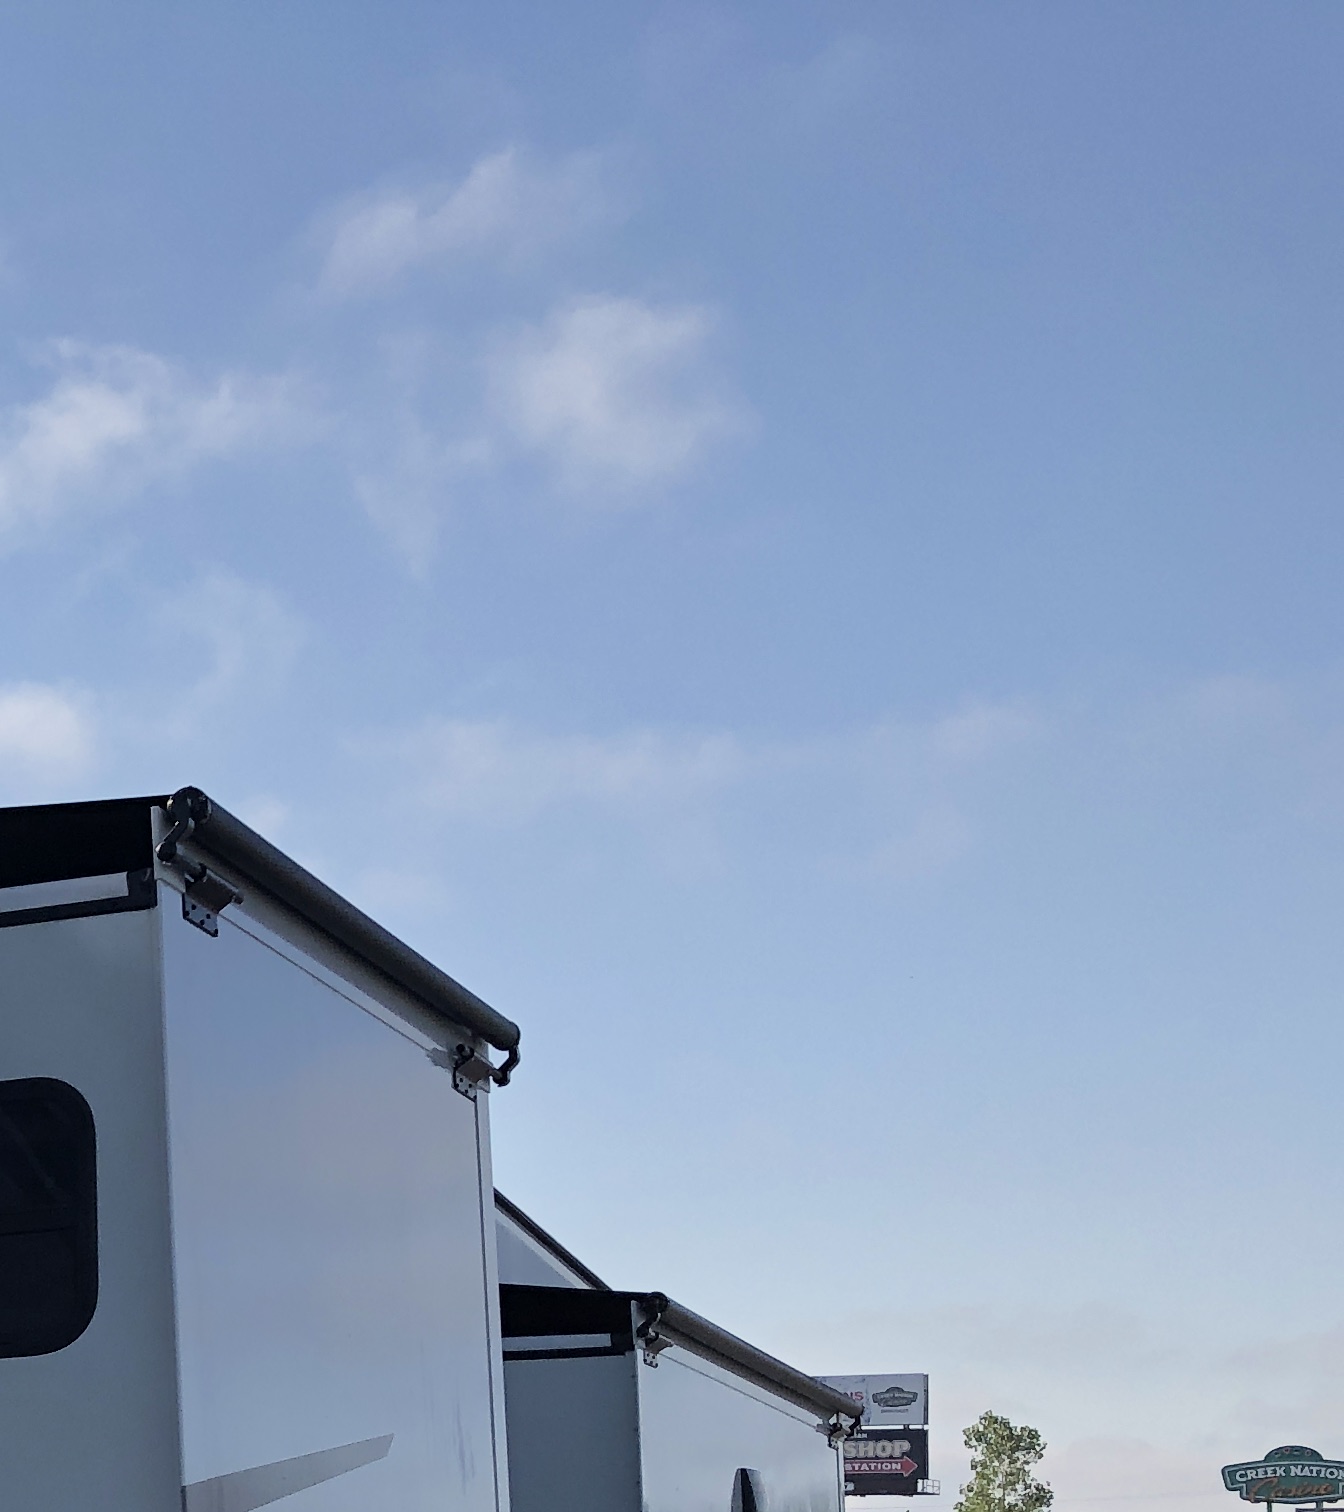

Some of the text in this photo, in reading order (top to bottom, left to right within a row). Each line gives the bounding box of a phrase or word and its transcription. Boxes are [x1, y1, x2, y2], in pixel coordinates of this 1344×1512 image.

[843, 1439, 911, 1458] SHOP
[844, 1462, 902, 1471] STATION
[1235, 1465, 1286, 1482] CREEK
